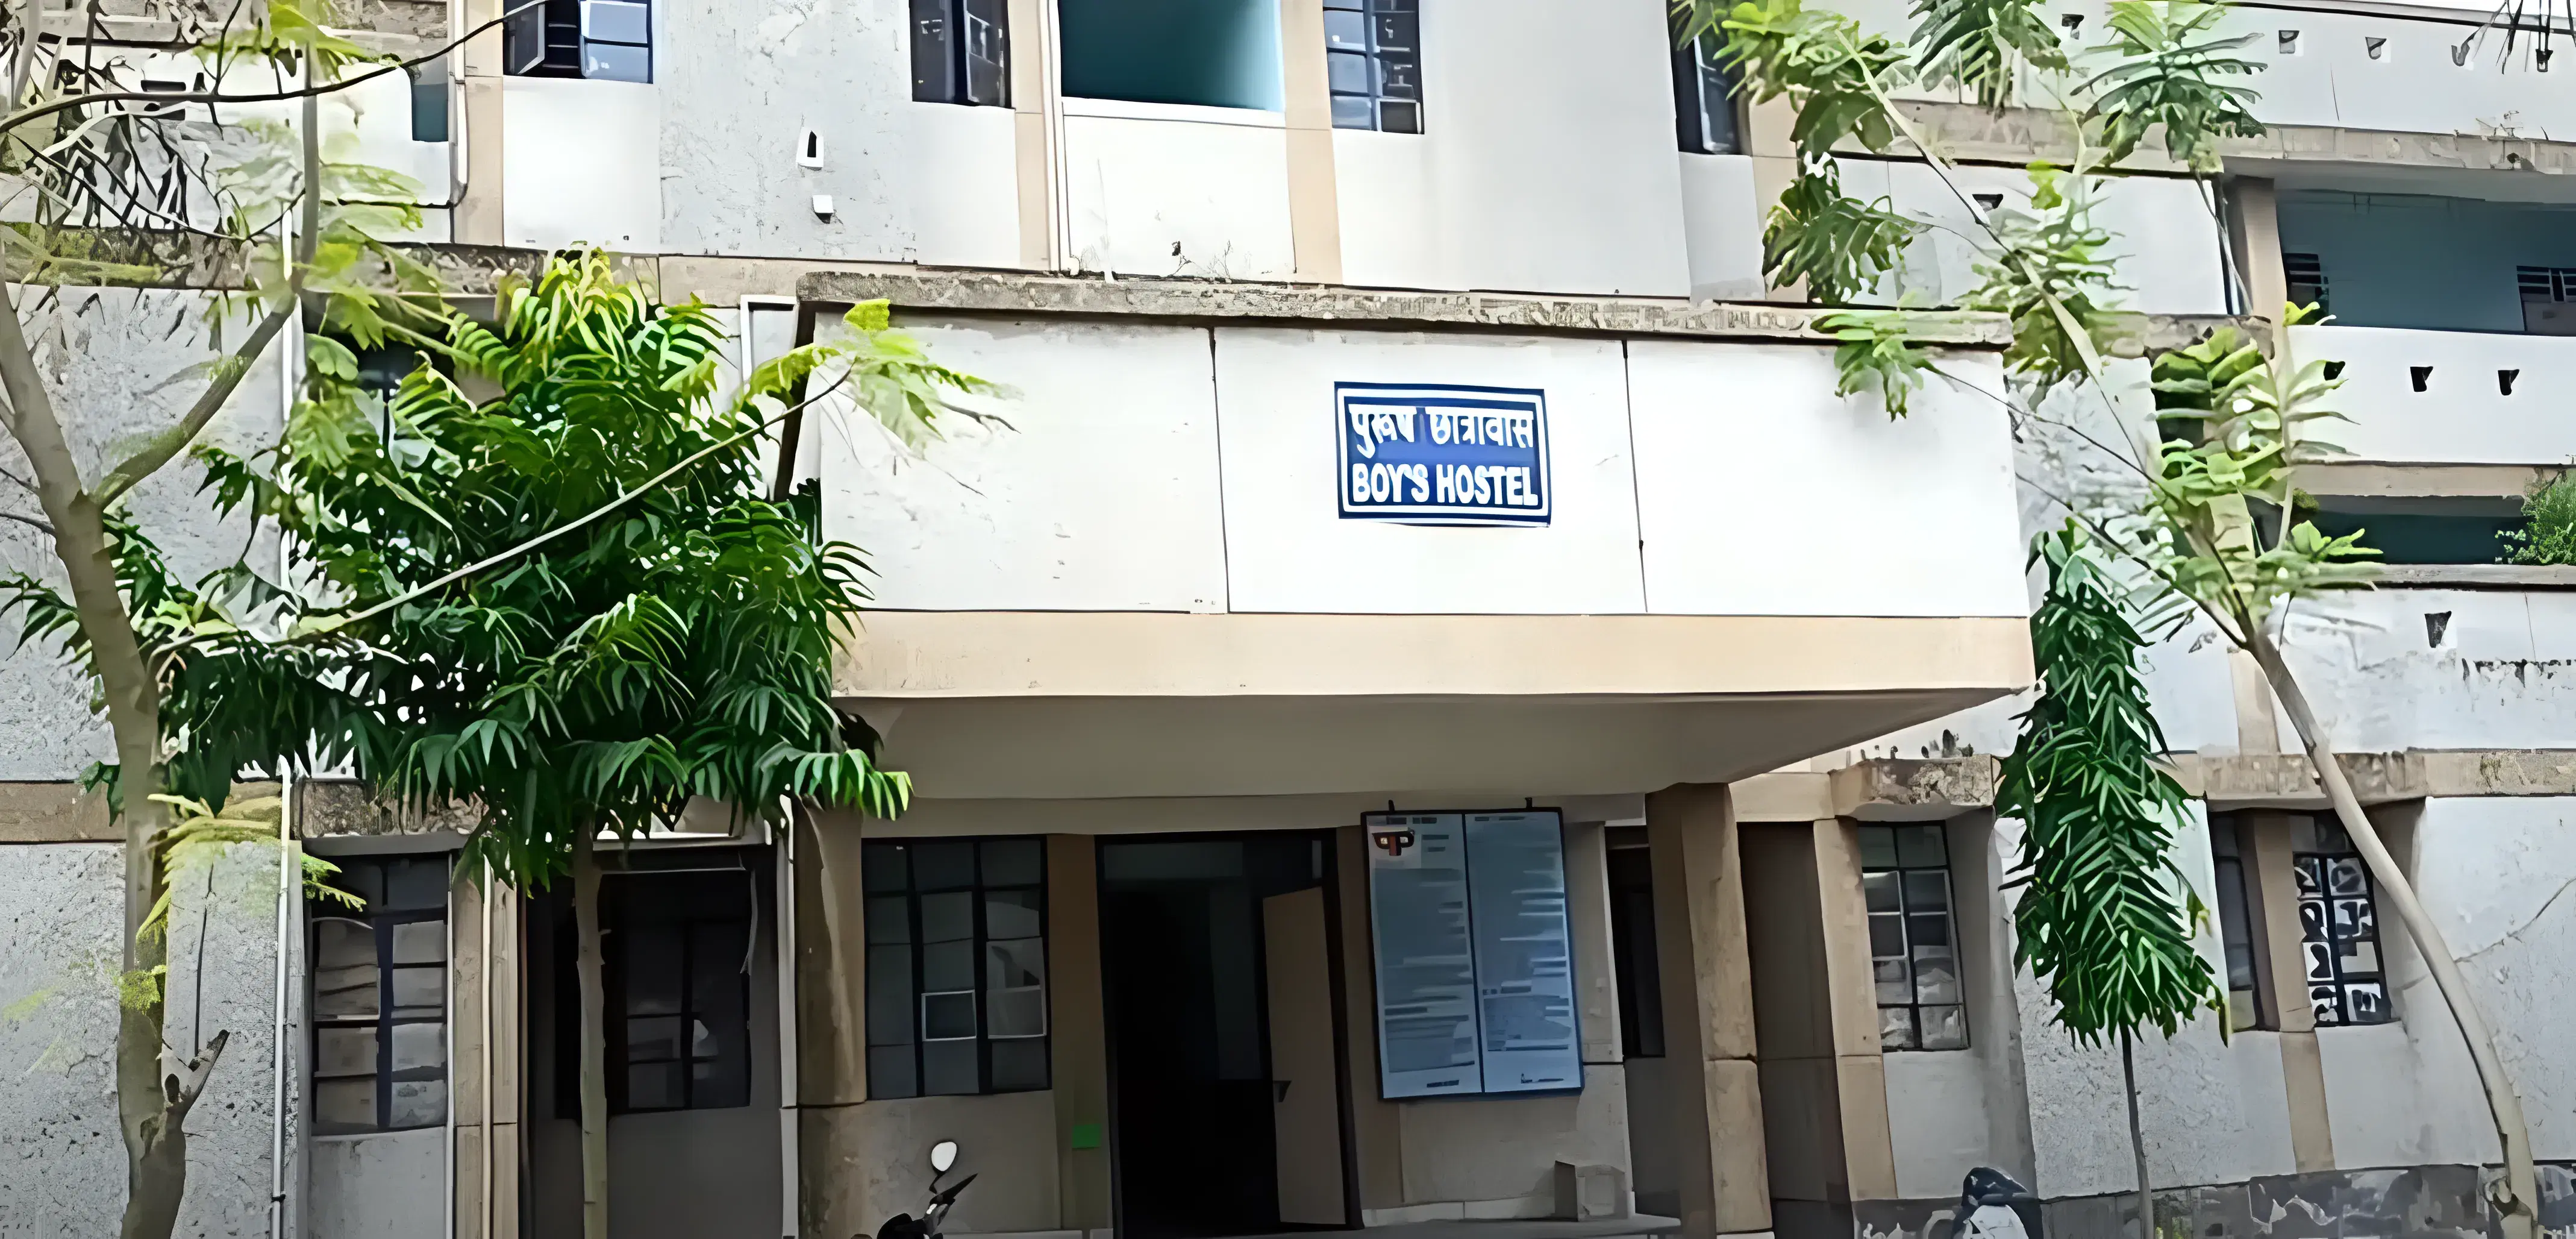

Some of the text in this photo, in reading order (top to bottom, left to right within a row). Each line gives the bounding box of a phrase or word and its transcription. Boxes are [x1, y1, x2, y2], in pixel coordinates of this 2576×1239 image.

[1425, 406, 1534, 448] छात्रावास
[1352, 463, 1539, 506] BOY'S HOSTEL
